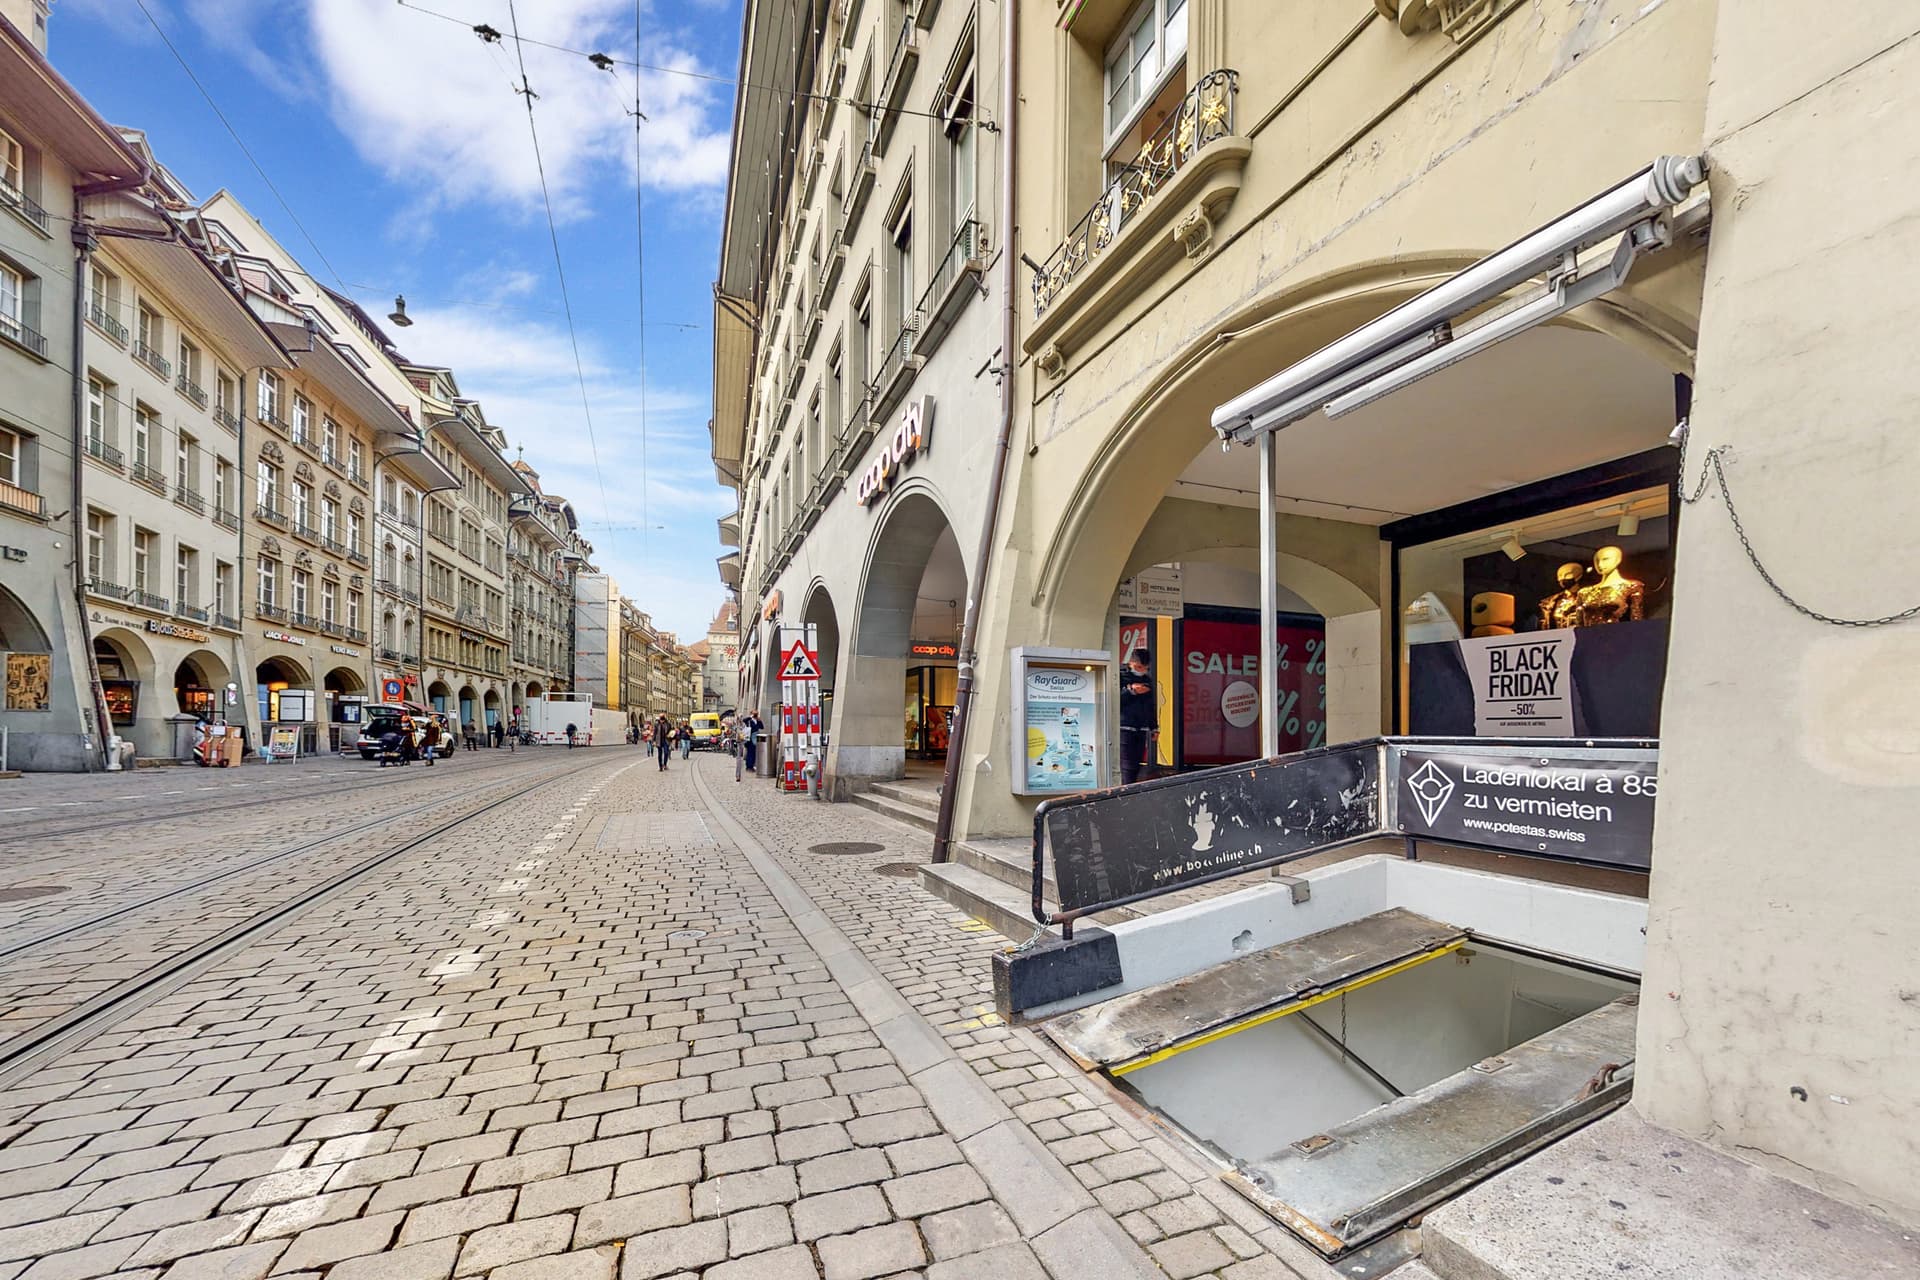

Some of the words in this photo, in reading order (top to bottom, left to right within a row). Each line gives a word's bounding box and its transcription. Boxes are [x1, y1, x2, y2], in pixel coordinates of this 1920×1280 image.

[857, 445, 890, 505] coop
[891, 395, 929, 464] city
[912, 645, 938, 656] coop
[938, 645, 955, 657] city
[1187, 651, 1258, 676] SALE
[1490, 645, 1558, 673] BLACK
[1489, 671, 1559, 698] FRIDAY
[1510, 703, 1535, 716] -50%
[1462, 765, 1586, 792] Ladenlokal
[1595, 774, 1613, 795] à
[1623, 775, 1658, 797] 85
[1463, 793, 1488, 809] zu
[1494, 797, 1612, 823] vermieten
[1463, 818, 1586, 842] www.potestas.swiss
